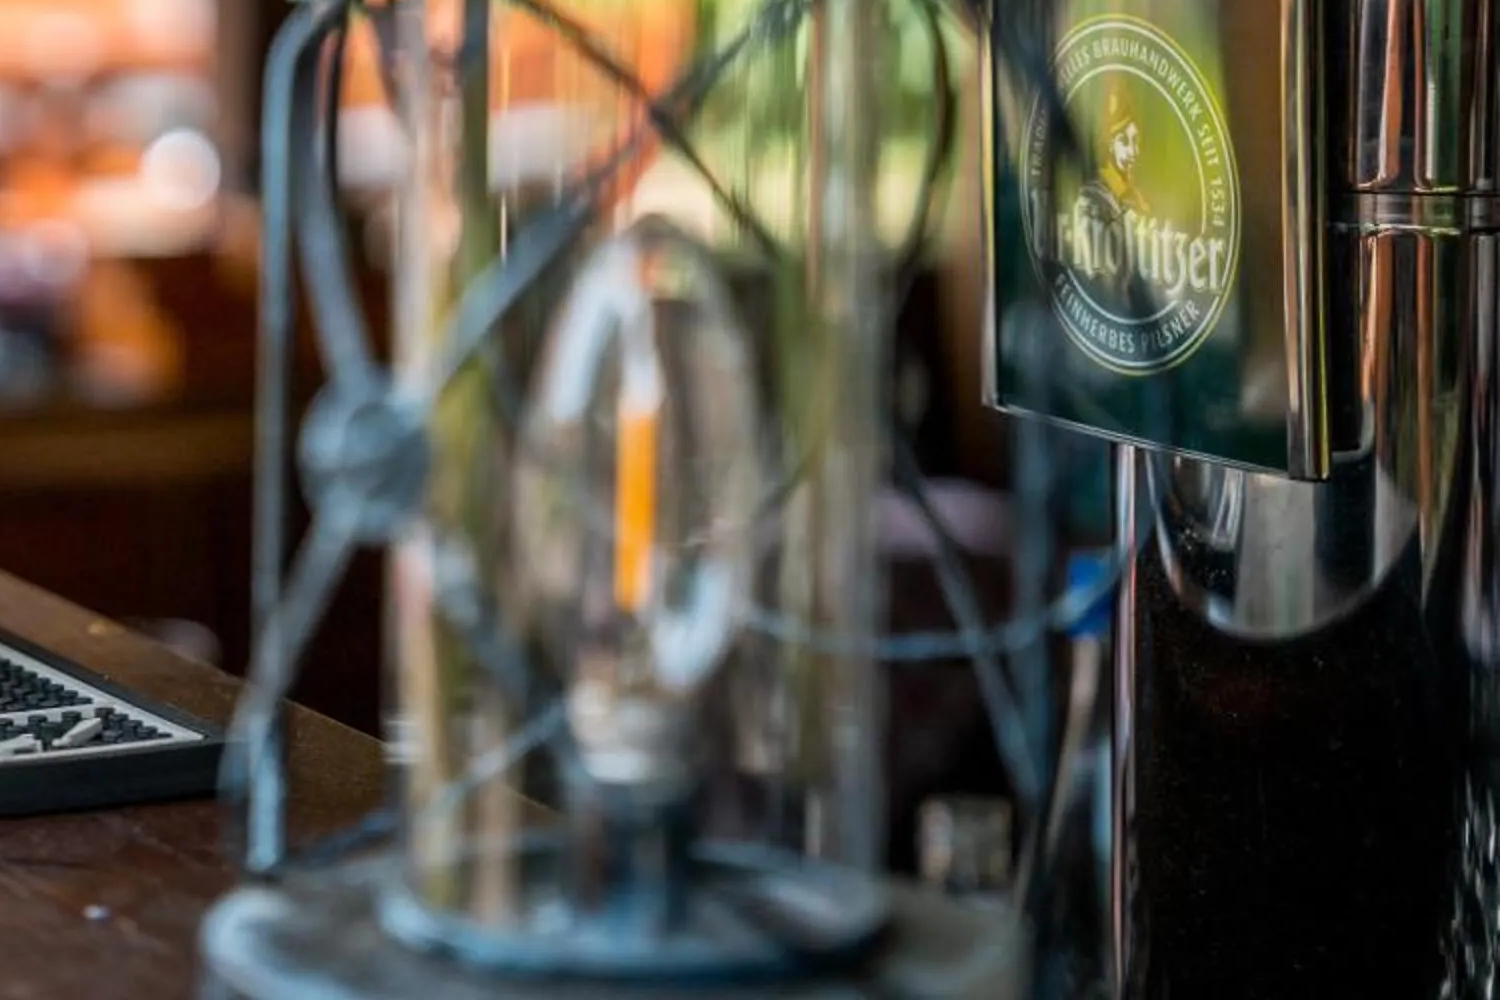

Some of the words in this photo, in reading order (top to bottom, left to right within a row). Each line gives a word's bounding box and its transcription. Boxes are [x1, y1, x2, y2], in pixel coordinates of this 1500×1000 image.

[1092, 37, 1202, 121] BRAUHANDWERK
[1197, 123, 1220, 167] SEIT
[1140, 299, 1202, 353] PILSNER
